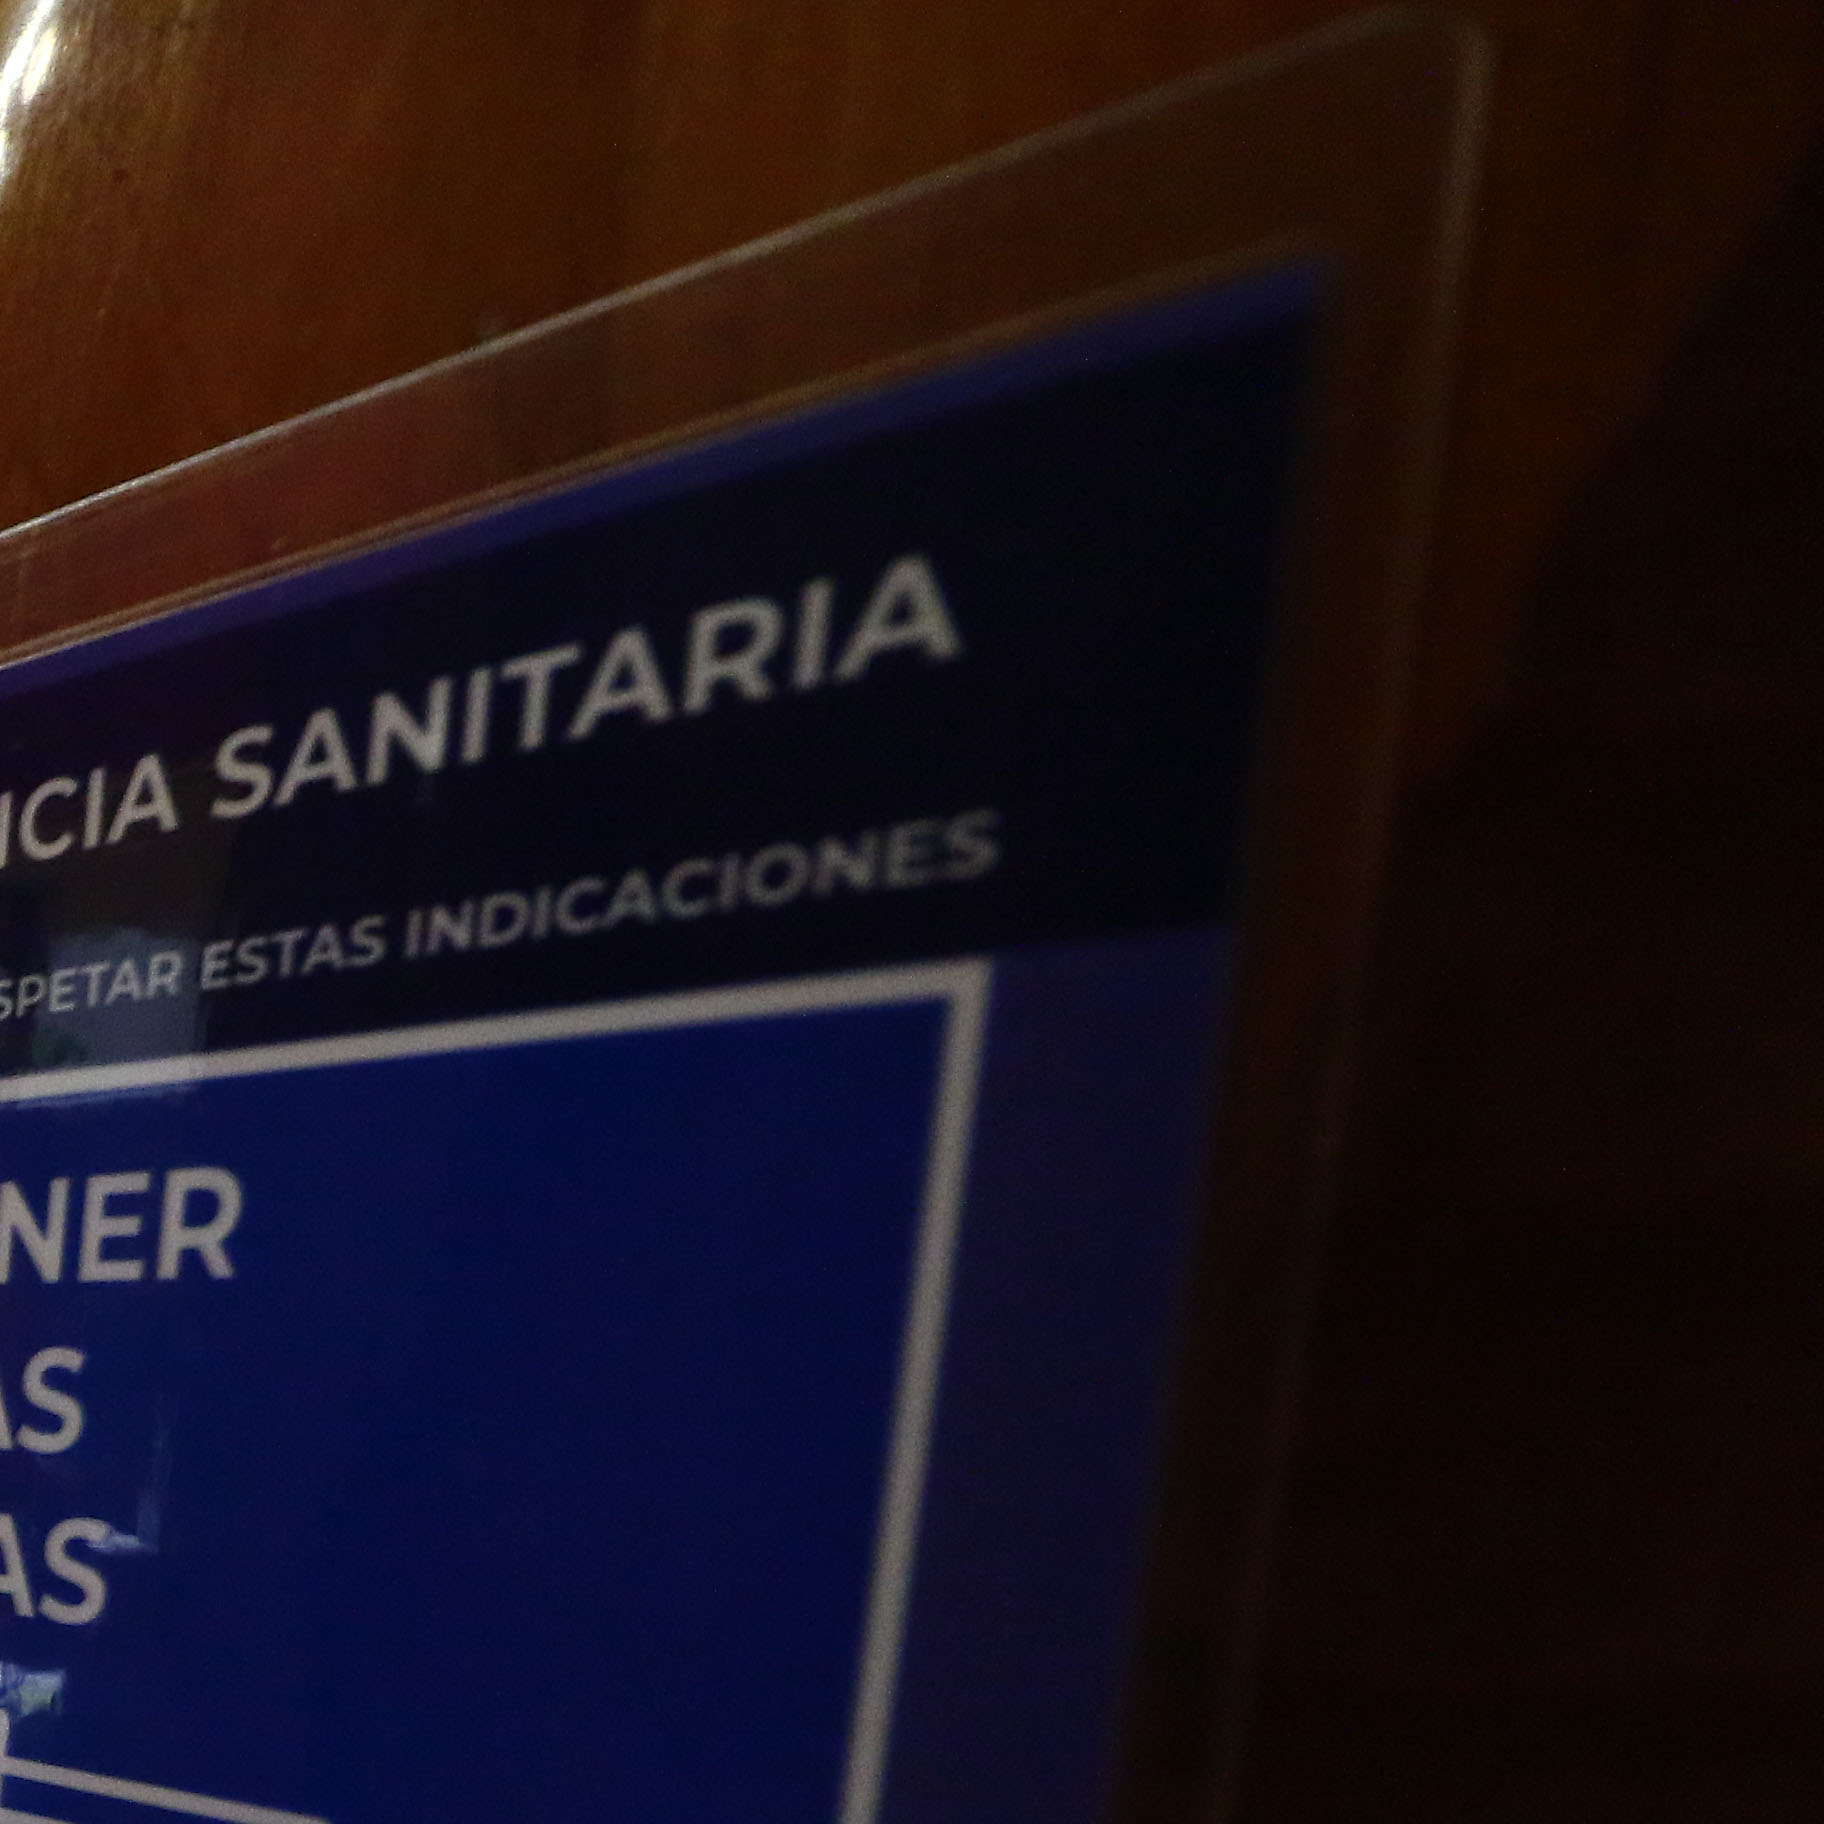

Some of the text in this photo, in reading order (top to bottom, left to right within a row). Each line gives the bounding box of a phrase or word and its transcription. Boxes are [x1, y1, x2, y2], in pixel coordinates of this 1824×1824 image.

[210, 554, 963, 819] SANITARIA
[200, 915, 386, 993] ESTAS
[403, 809, 1003, 960] INDICACIONES
